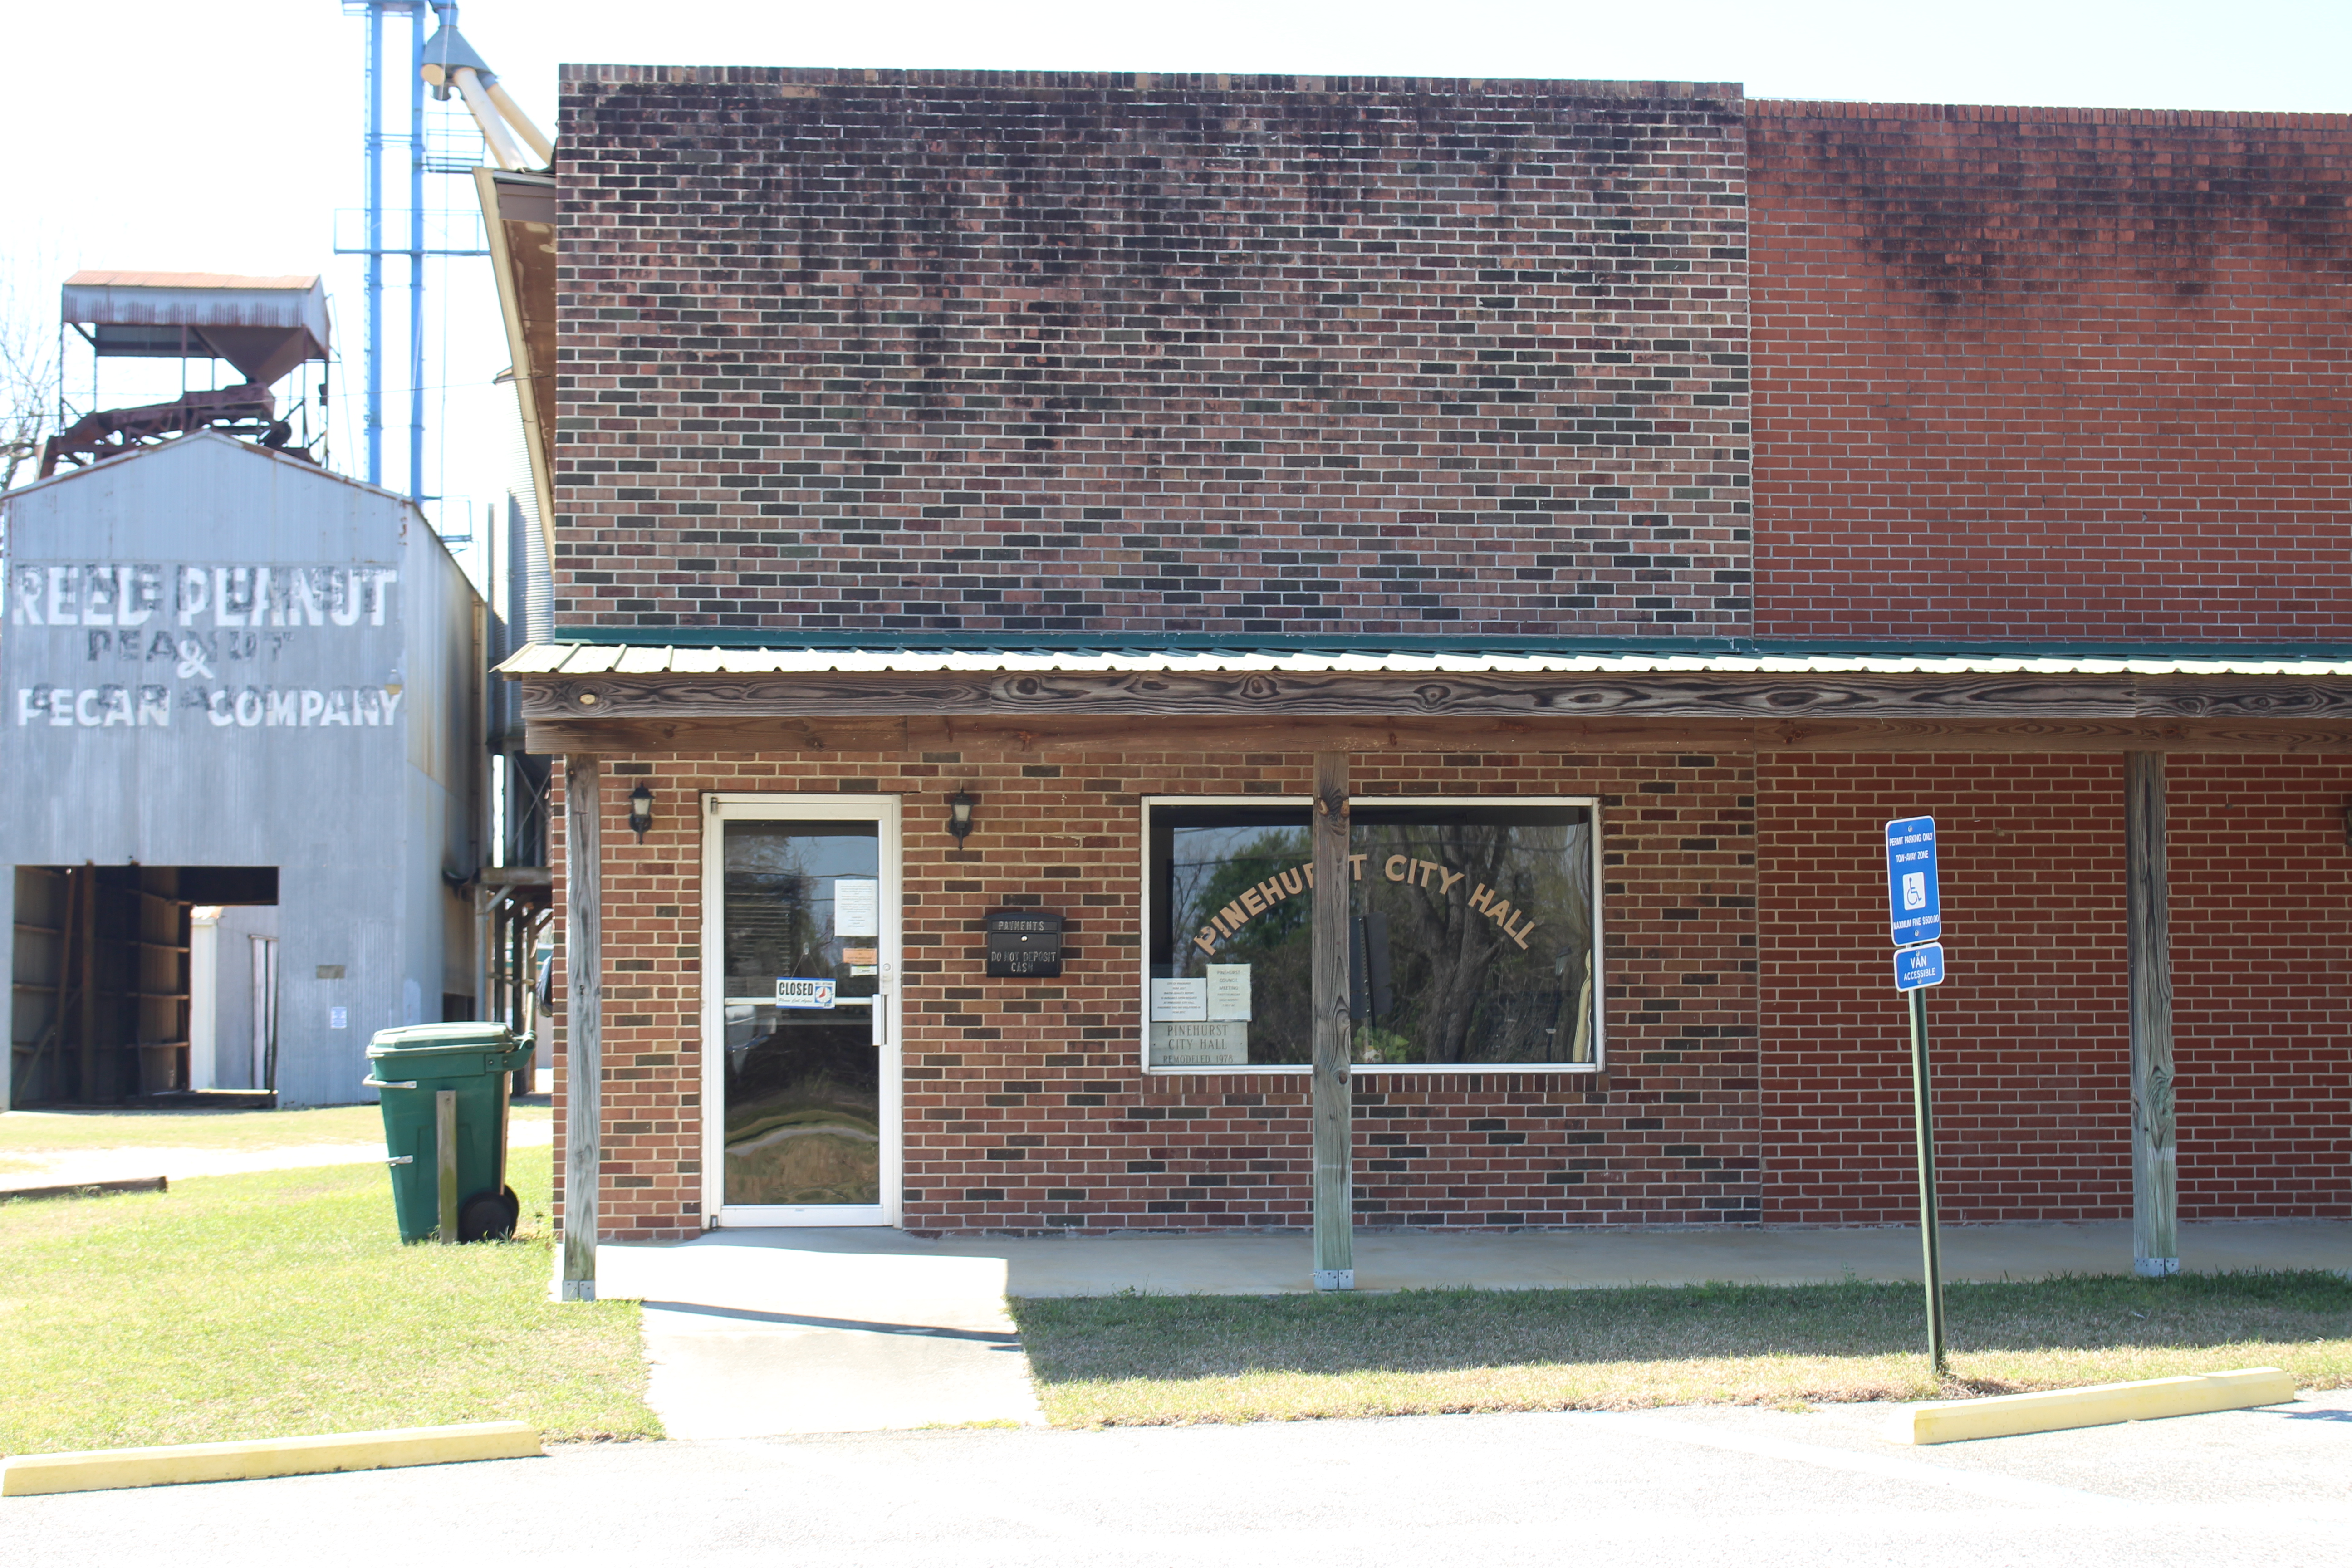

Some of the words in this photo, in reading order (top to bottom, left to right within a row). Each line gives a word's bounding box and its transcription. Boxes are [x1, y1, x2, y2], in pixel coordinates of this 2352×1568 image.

[179, 567, 397, 626] PEANUT
[177, 639, 215, 679] &
[18, 688, 171, 726] PECAN
[208, 689, 403, 727] COMPANY
[1889, 836, 1904, 847] PERMIT
[1905, 833, 1921, 844] PARKING
[1922, 832, 1933, 842] ONLY
[1895, 852, 1916, 863] TOW-AWAY
[1917, 850, 1929, 860] ZONE
[1193, 854, 1367, 956] PINEHUT
[1385, 854, 1465, 895] CITY
[1468, 882, 1536, 950] HALL
[998, 921, 1044, 931] PAYMENTS
[1893, 919, 1911, 930] MAXIMUM
[1912, 917, 1921, 927] FINE
[1922, 914, 1939, 925] $500.00
[991, 951, 1002, 962] DO
[1023, 951, 1056, 962] DEPOSIT
[1910, 955, 1927, 969] VAN
[1011, 961, 1033, 972] CASH
[1904, 967, 1936, 981] ACCESSIBLE
[779, 982, 813, 996] CLOSED
[1167, 1024, 1228, 1036] PINEHURST
[1168, 1039, 1193, 1050] CITY
[1200, 1039, 1228, 1050] HALL
[1216, 1054, 1234, 1063] 1978
